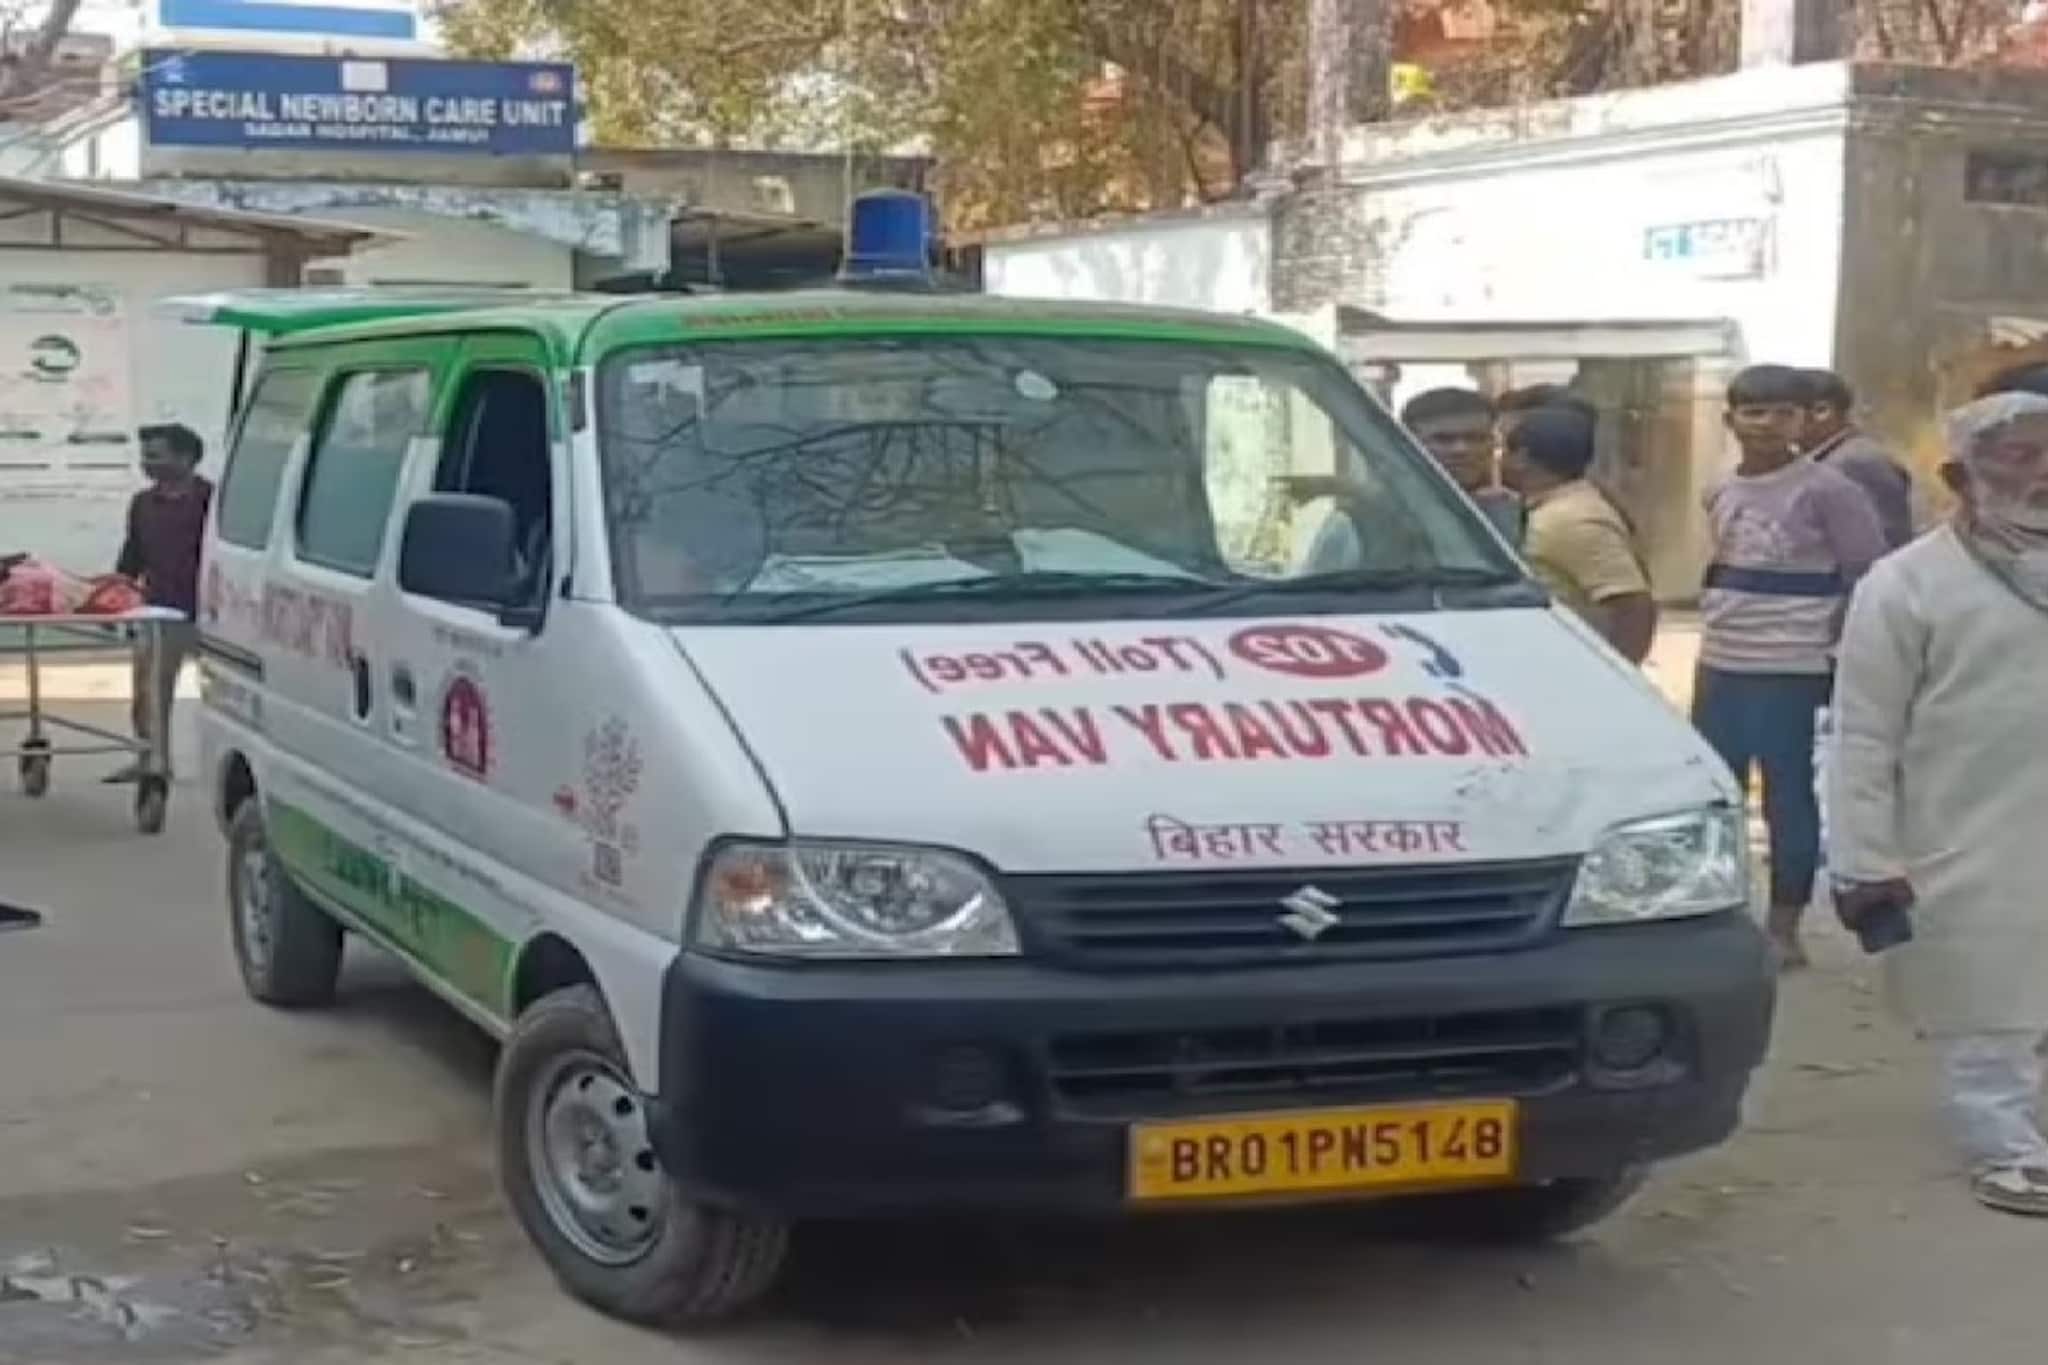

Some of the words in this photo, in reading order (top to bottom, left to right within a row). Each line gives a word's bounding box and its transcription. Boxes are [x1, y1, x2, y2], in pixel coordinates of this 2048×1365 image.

[156, 87, 274, 119] SPECIAL
[279, 92, 417, 123] NEWBORN
[427, 96, 497, 124] CARE
[502, 99, 566, 126] UNIT
[1147, 813, 1286, 859] बिहार
[1302, 819, 1467, 856] सरकार
[1170, 1115, 1503, 1184] BR01PN5148
